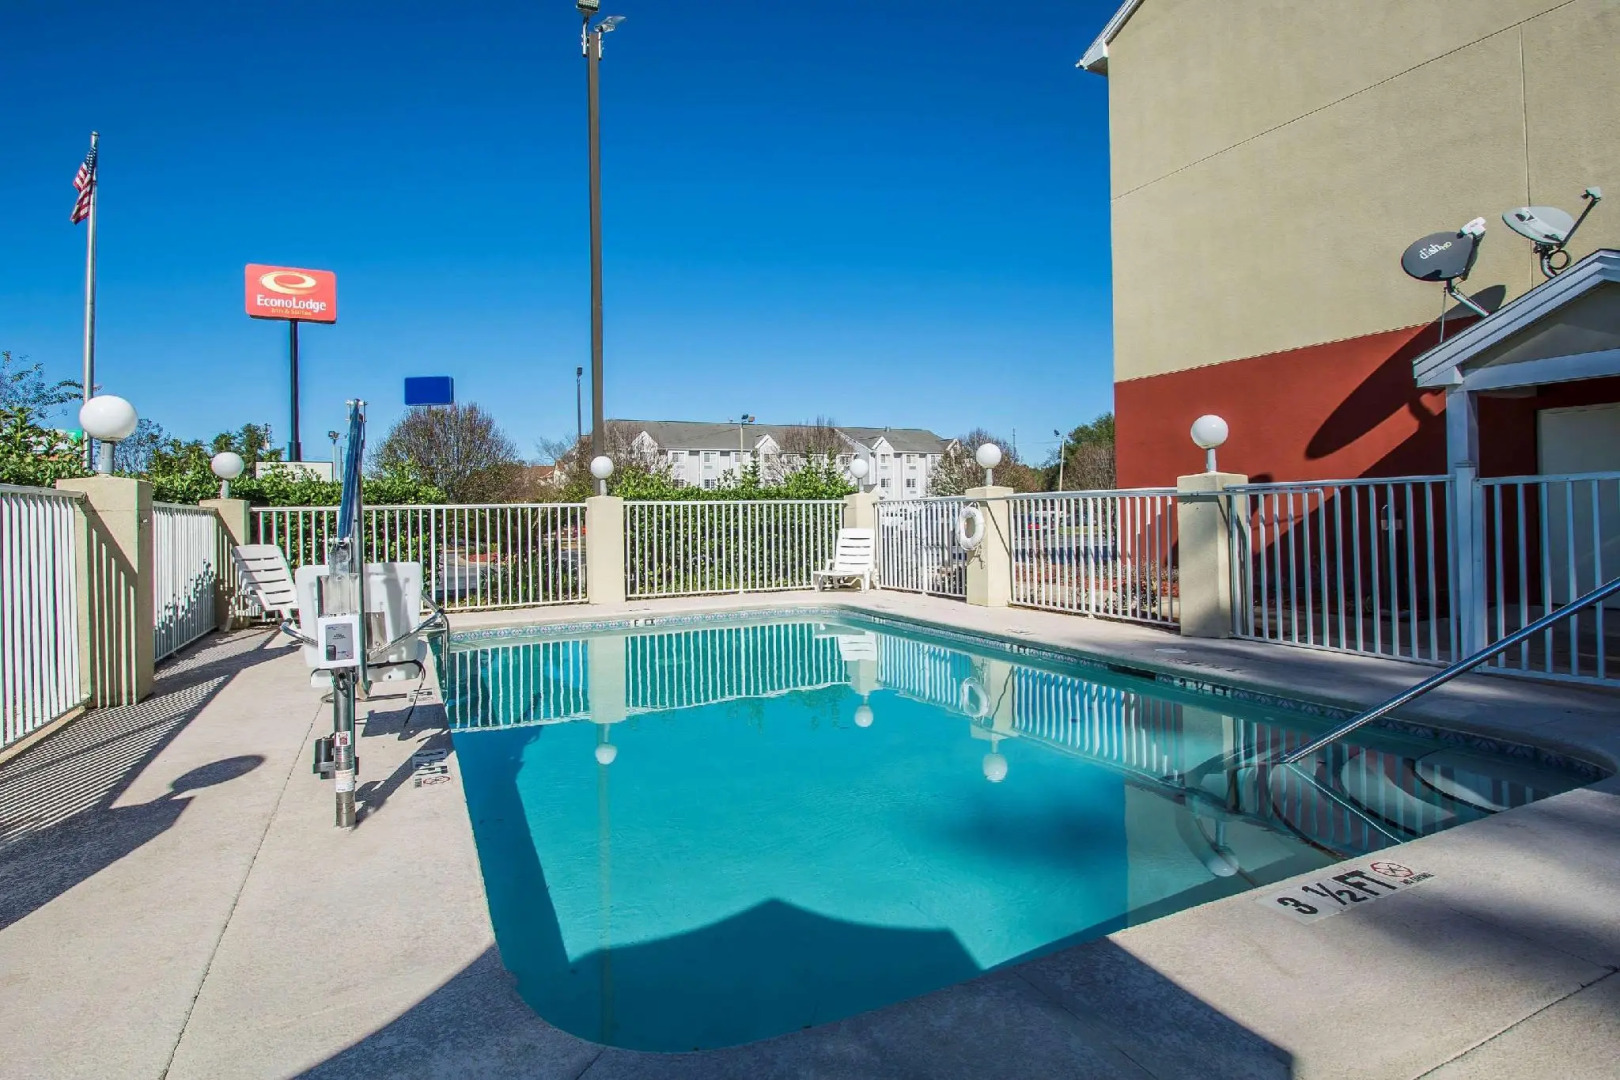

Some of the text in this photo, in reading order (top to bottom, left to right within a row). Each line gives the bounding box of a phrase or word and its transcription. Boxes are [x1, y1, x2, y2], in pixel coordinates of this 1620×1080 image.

[257, 294, 327, 313] EconoLodge
[1277, 896, 1319, 915] 3
[1332, 869, 1398, 896] FT
